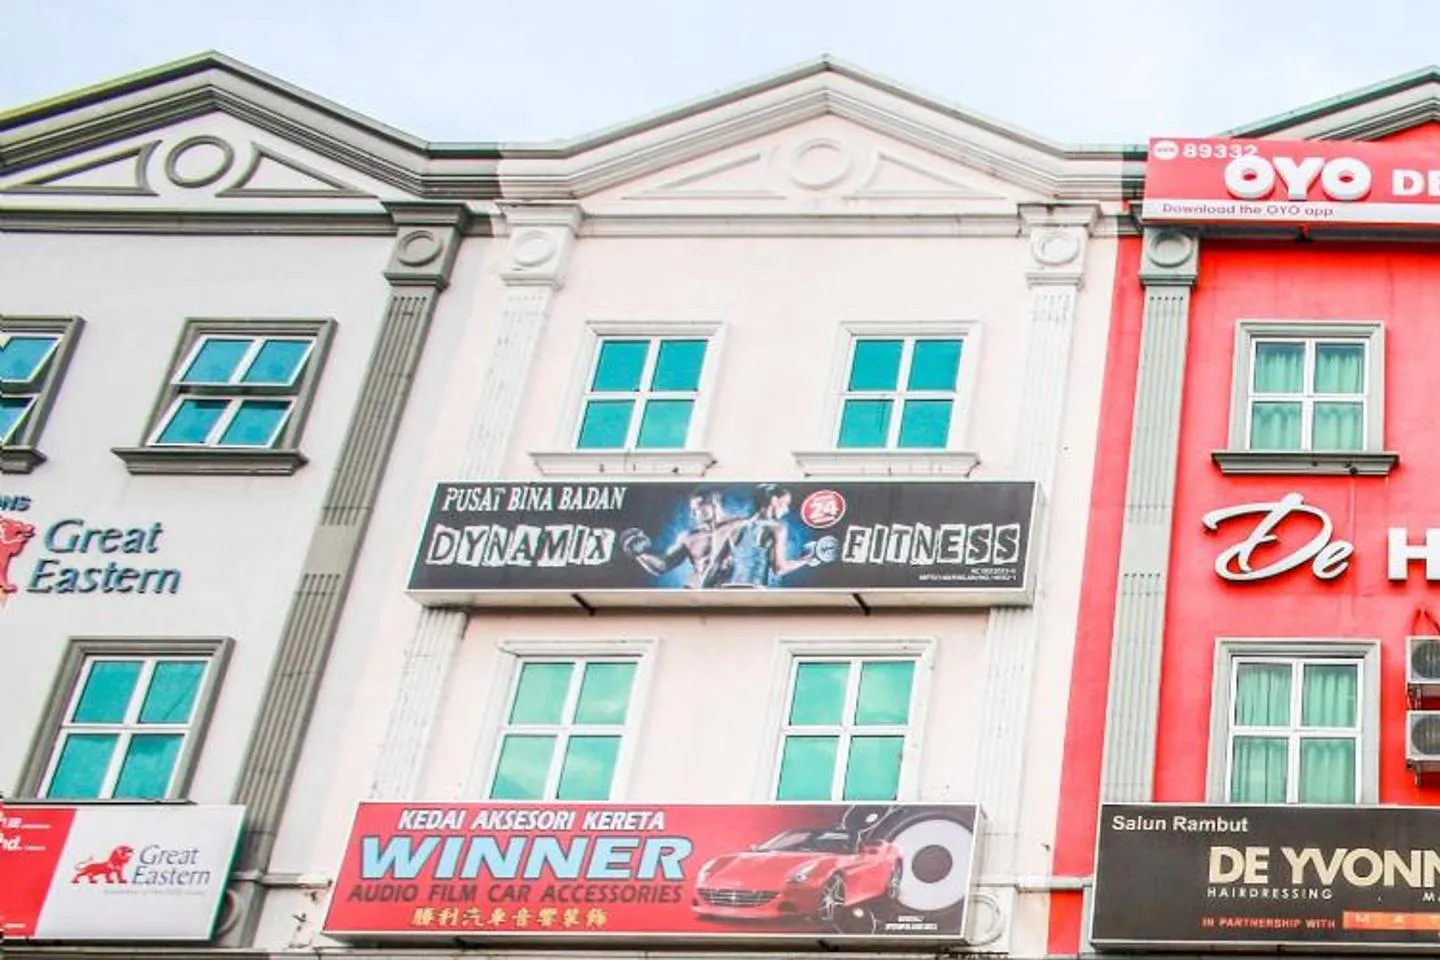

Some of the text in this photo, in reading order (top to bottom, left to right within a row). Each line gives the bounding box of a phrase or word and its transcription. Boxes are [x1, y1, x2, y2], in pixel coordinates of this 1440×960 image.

[1183, 143, 1259, 159] 89332
[1224, 156, 1372, 201] OYO
[1163, 203, 1333, 219] Download the OYO app
[441, 487, 628, 512] PUSAT BINA BADAN
[44, 518, 164, 553] Great
[425, 523, 616, 567] DYNAMIX
[841, 523, 1021, 565] FITNESS
[1202, 492, 1355, 582] De
[26, 558, 182, 594] Eastern
[398, 810, 665, 832] KEDAI AKSESORI KERETA
[1112, 815, 1249, 833] Salun Rambut
[140, 844, 200, 865] Great
[359, 835, 694, 881] WINNER
[1208, 846, 1271, 885] DE
[132, 865, 211, 885] Eastern
[350, 884, 684, 904] AUDIO FILM CAR ACCESSORIES
[1207, 887, 1334, 900] HAIRDRESSING
[1202, 917, 1336, 930] IN PARTNERSHIP WITH
